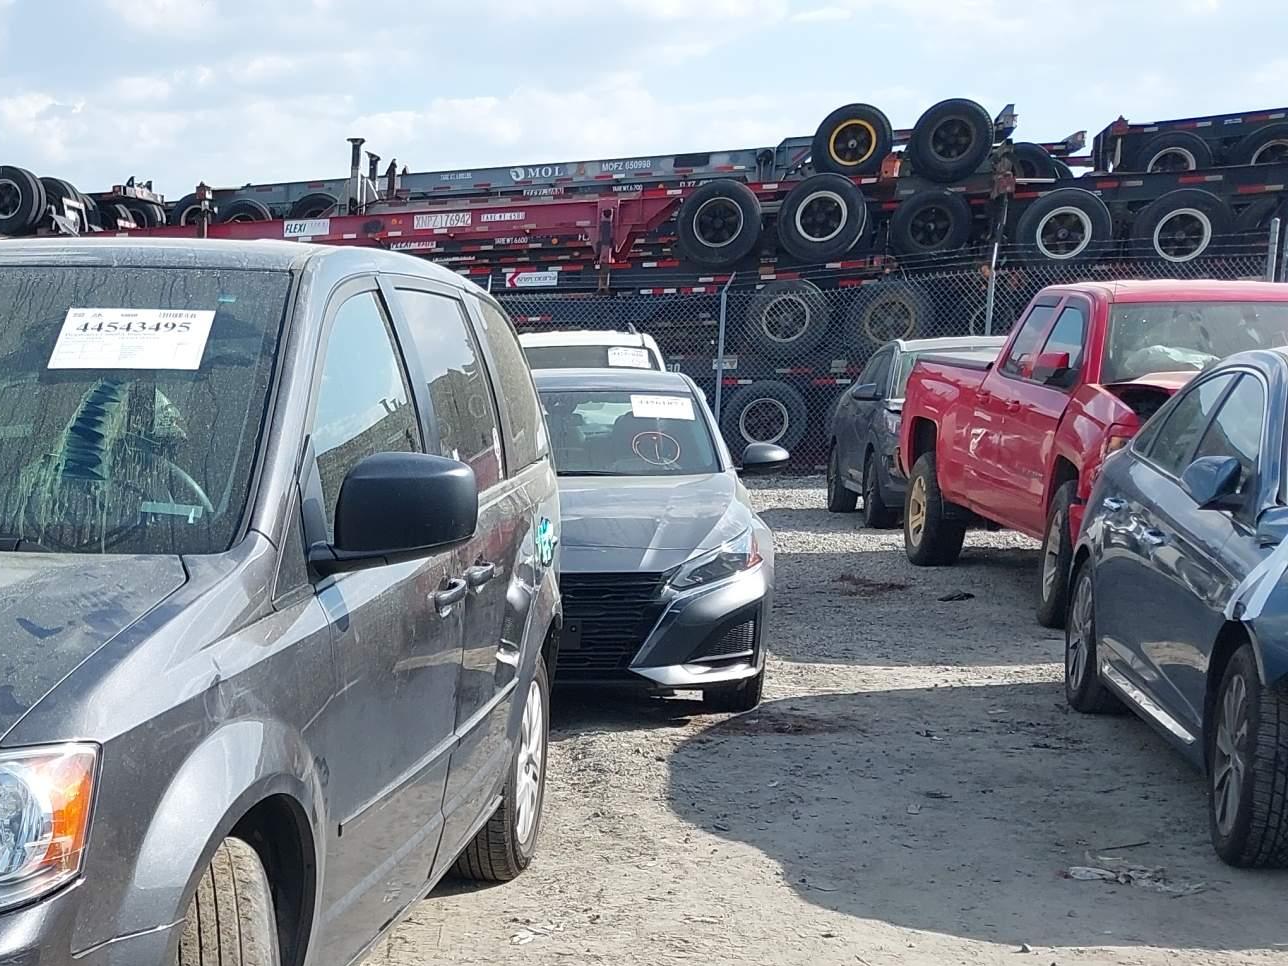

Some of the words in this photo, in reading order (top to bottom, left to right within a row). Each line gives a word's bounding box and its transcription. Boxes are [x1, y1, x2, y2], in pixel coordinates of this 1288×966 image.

[527, 166, 564, 178] MOL
[285, 223, 307, 234] FLEXI
[76, 321, 192, 333] 44543495
